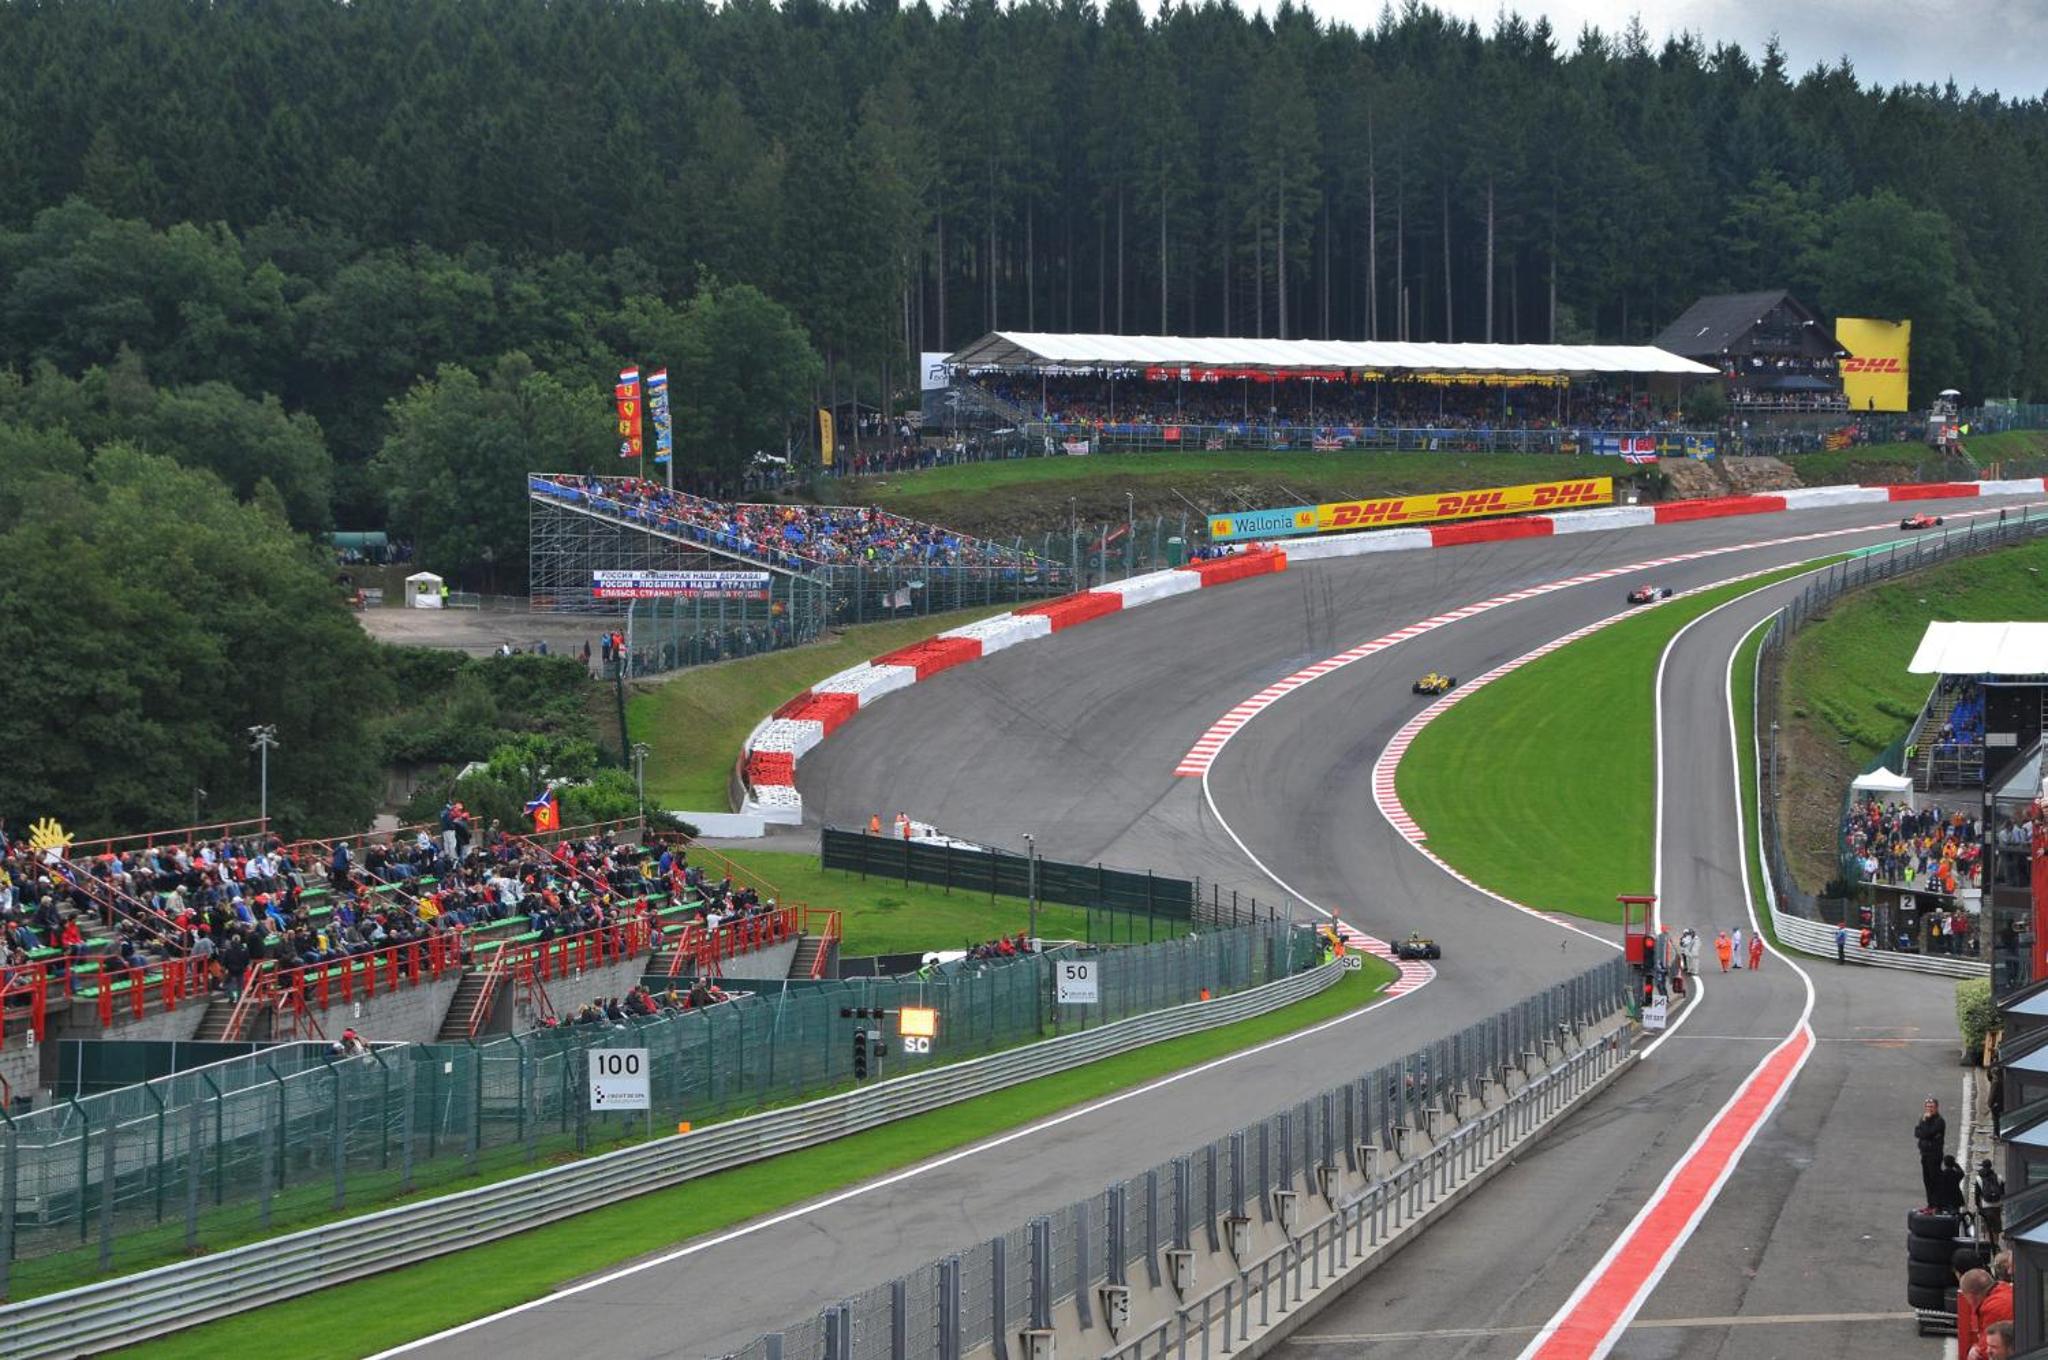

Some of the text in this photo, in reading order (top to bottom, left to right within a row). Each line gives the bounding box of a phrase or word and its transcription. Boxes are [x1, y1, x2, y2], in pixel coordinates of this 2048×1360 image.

[1844, 357, 1901, 373] DHL
[1533, 482, 1600, 506] DHL
[1436, 491, 1507, 516] DHL
[1332, 501, 1409, 526] DHL
[1235, 516, 1293, 532] Wallonia
[693, 571, 717, 580] НАША
[639, 581, 687, 589] ЛЮБИМАЯ
[690, 581, 717, 589] НАША
[1904, 896, 1912, 907] 2
[1343, 957, 1360, 968] SC
[1066, 965, 1087, 979] 50
[904, 1037, 929, 1052] SC
[598, 1054, 639, 1074] 100
